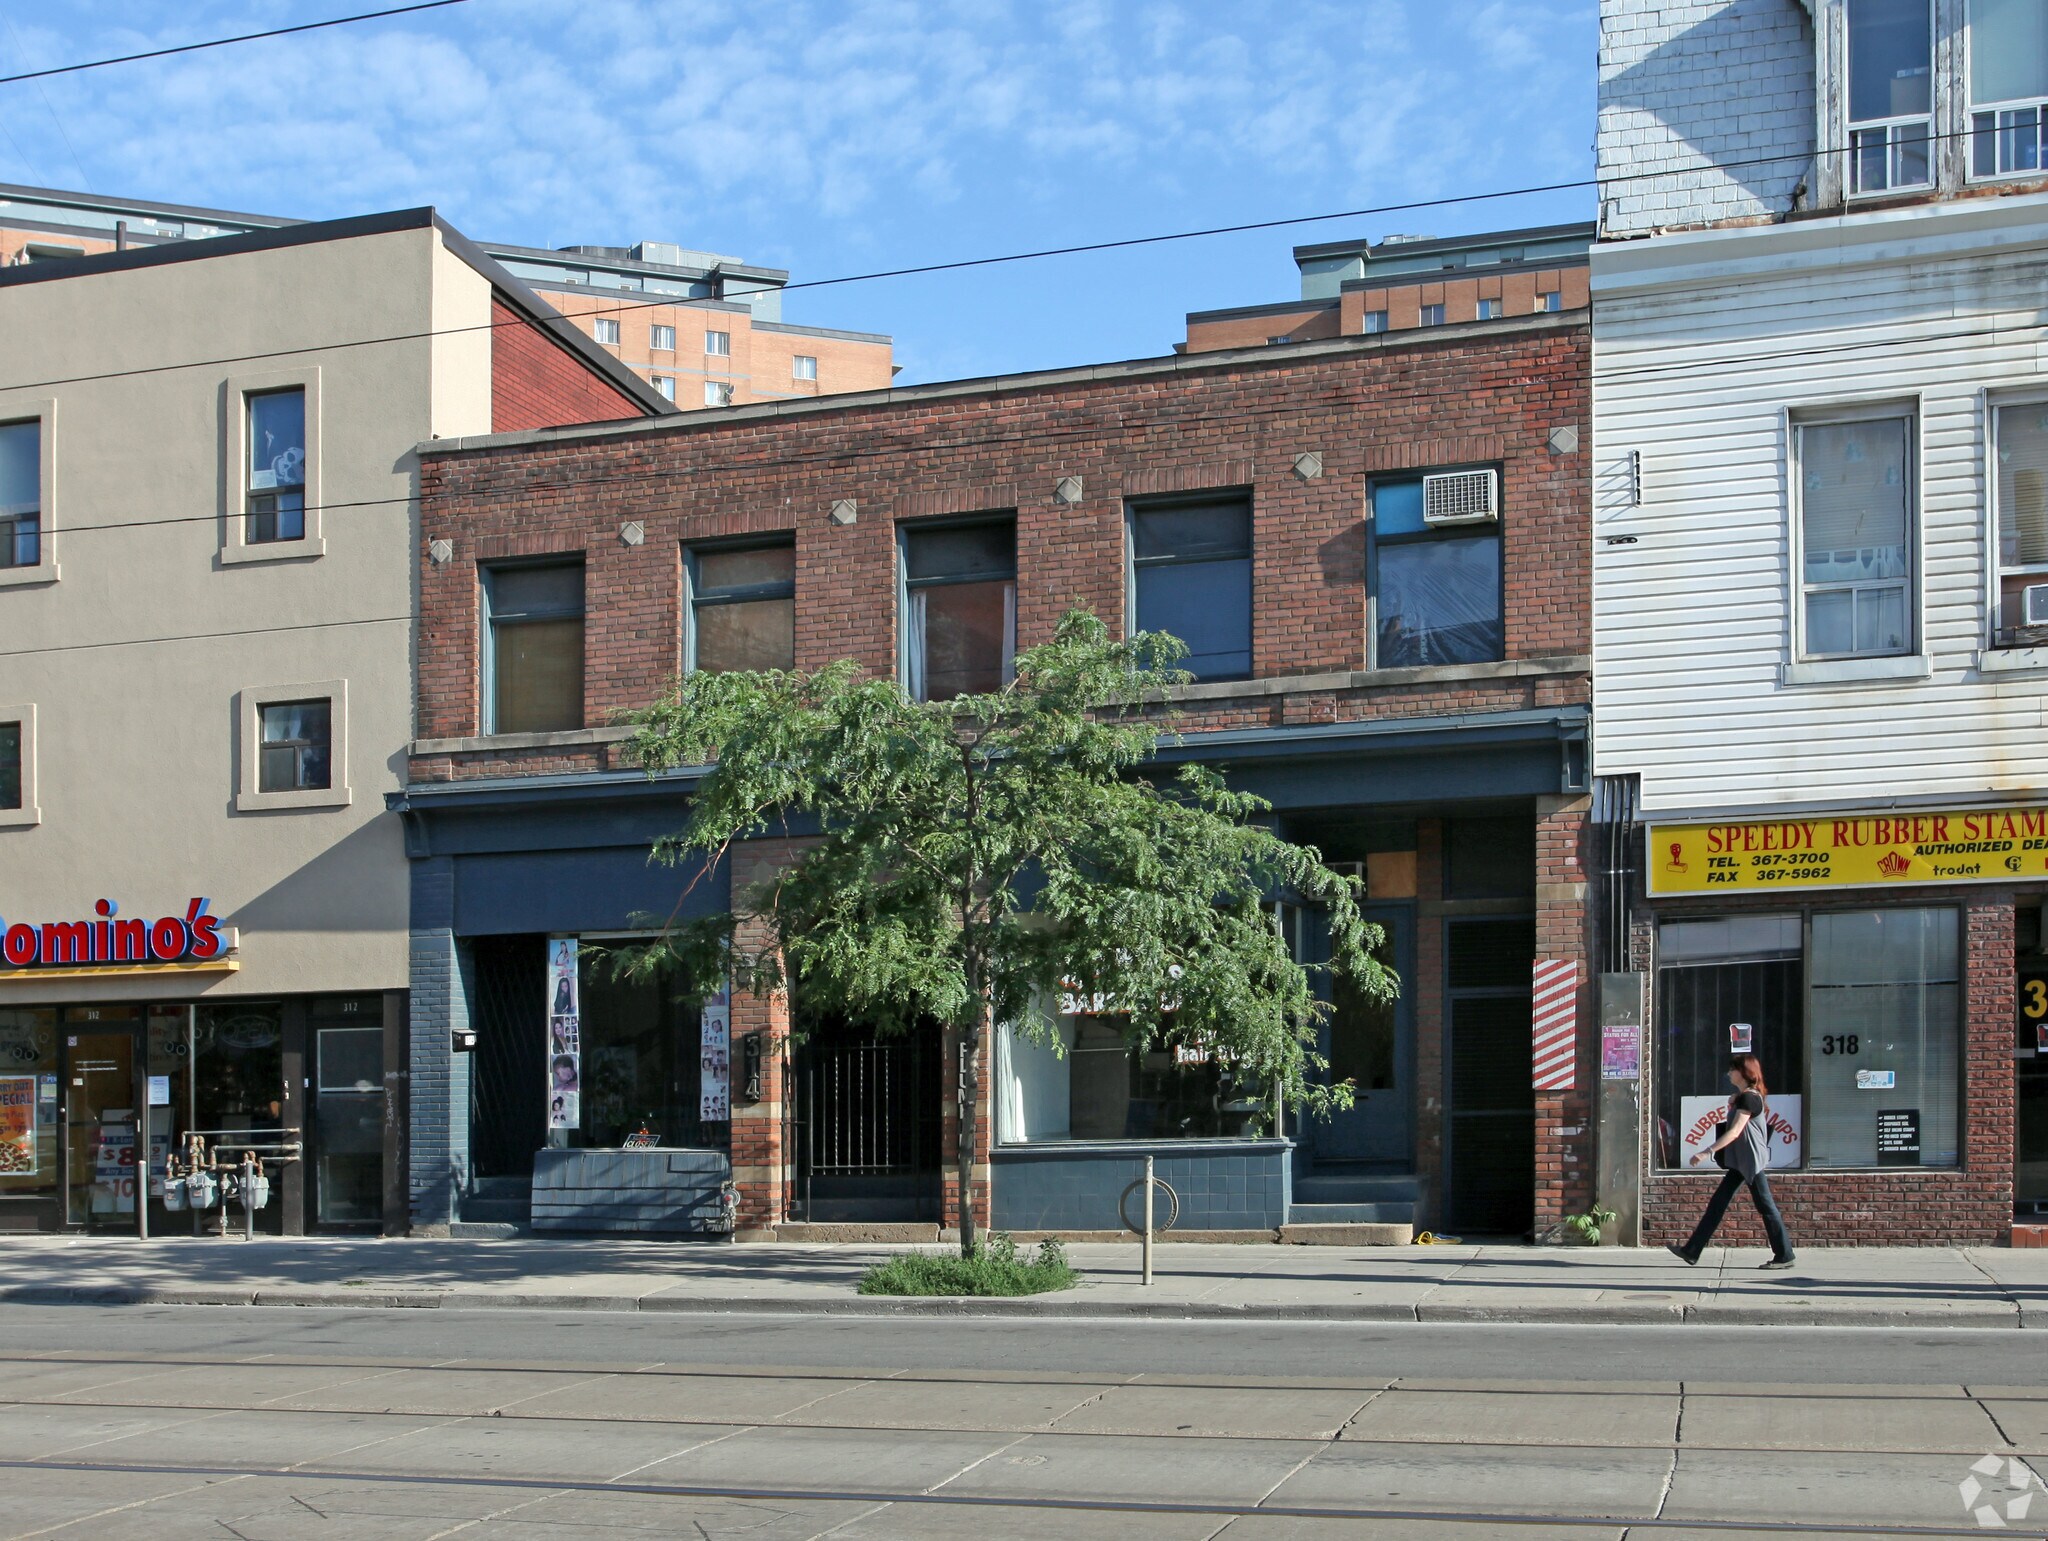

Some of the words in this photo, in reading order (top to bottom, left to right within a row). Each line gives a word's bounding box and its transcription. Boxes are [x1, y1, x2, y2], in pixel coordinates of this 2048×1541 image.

[1707, 822, 1818, 853] SPEEDY
[1832, 815, 1950, 847] RUBBER
[1964, 809, 2047, 840] STAM
[1914, 840, 2013, 856] AUTHORIZED
[1708, 857, 1741, 867] TEL.
[1751, 853, 1830, 866] 367-3700
[1877, 850, 1911, 874] CROWN
[1933, 863, 1981, 876] trodat
[1707, 871, 1738, 882] FAX
[1757, 868, 1831, 881] 367-5962
[0, 897, 226, 965] omino's
[88, 1011, 99, 1019] 312
[344, 1003, 357, 1011] 312
[1822, 1034, 1859, 1055] 318
[1763, 1106, 1798, 1145] AMPS
[626, 1140, 654, 1148] CLOSED
